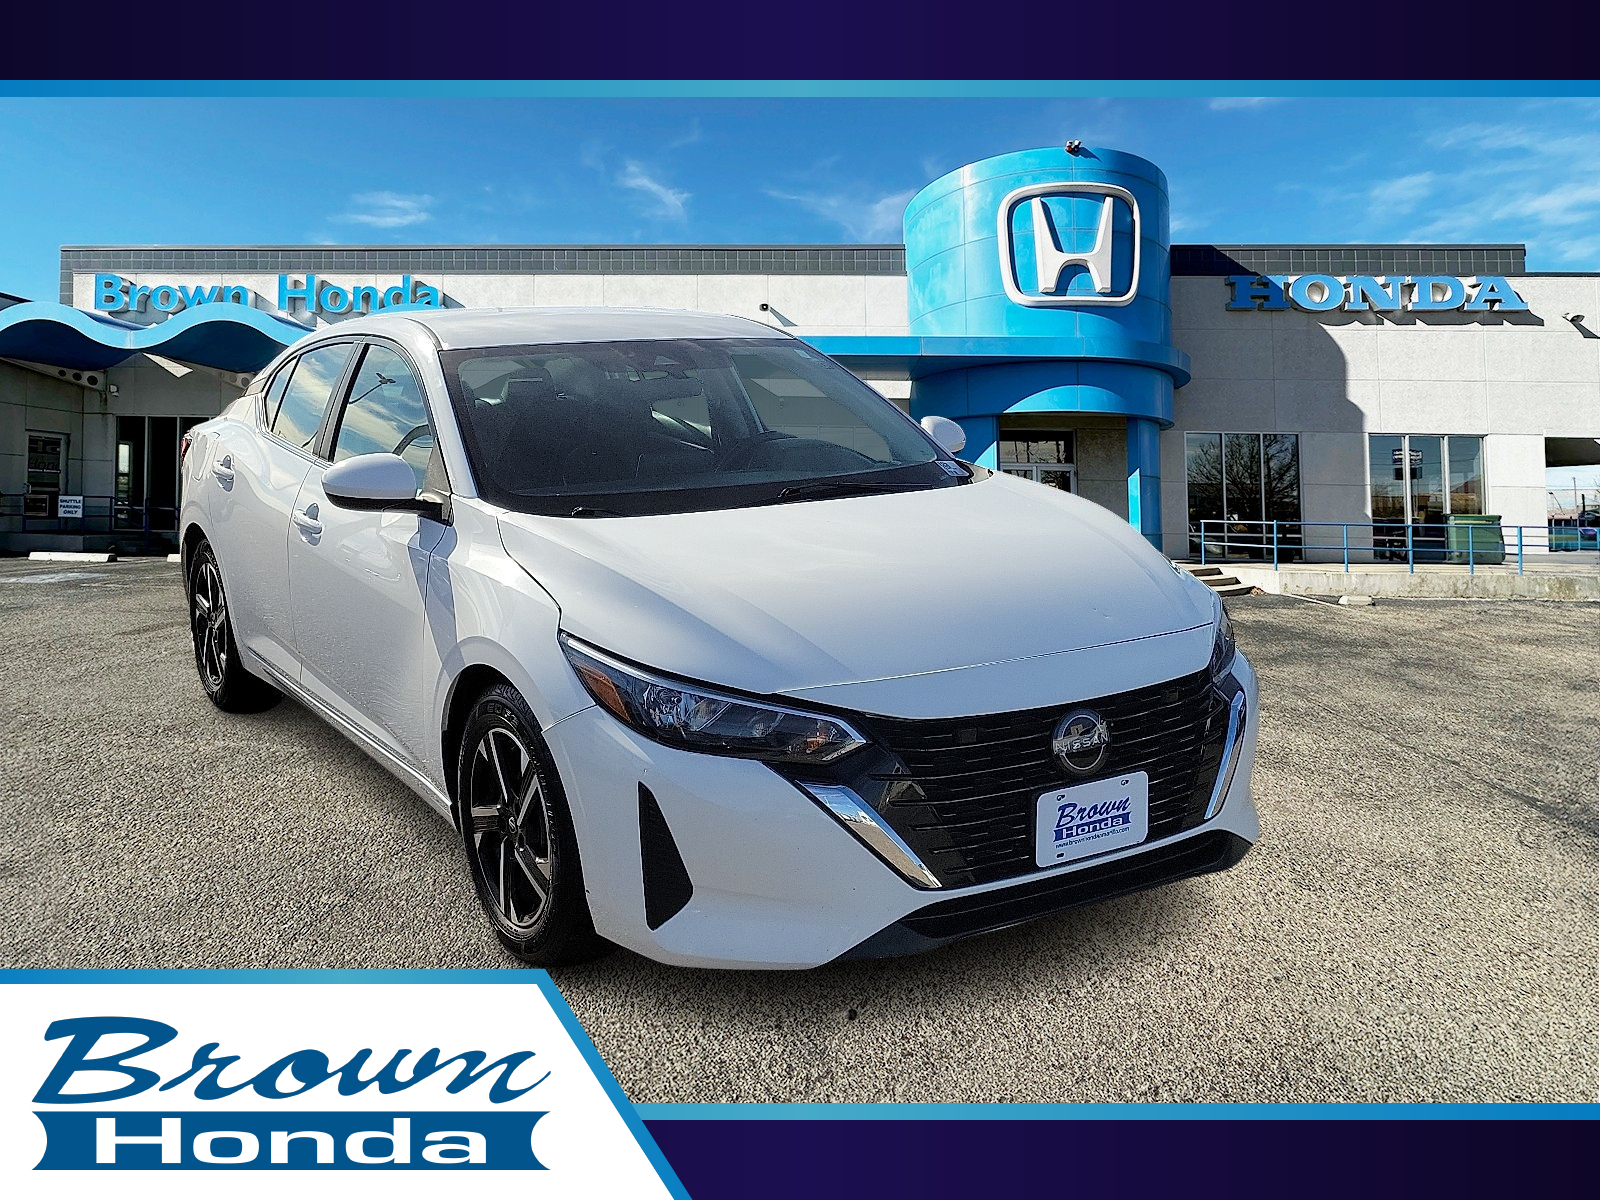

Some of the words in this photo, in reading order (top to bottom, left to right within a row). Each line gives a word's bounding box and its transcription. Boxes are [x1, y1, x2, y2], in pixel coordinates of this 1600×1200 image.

[95, 273, 249, 311] Brown
[277, 273, 441, 311] Honda
[1226, 275, 1528, 312] HONDA
[1055, 732, 1109, 753] NISSAN
[1055, 796, 1131, 829] Brown
[1062, 816, 1124, 839] Honda
